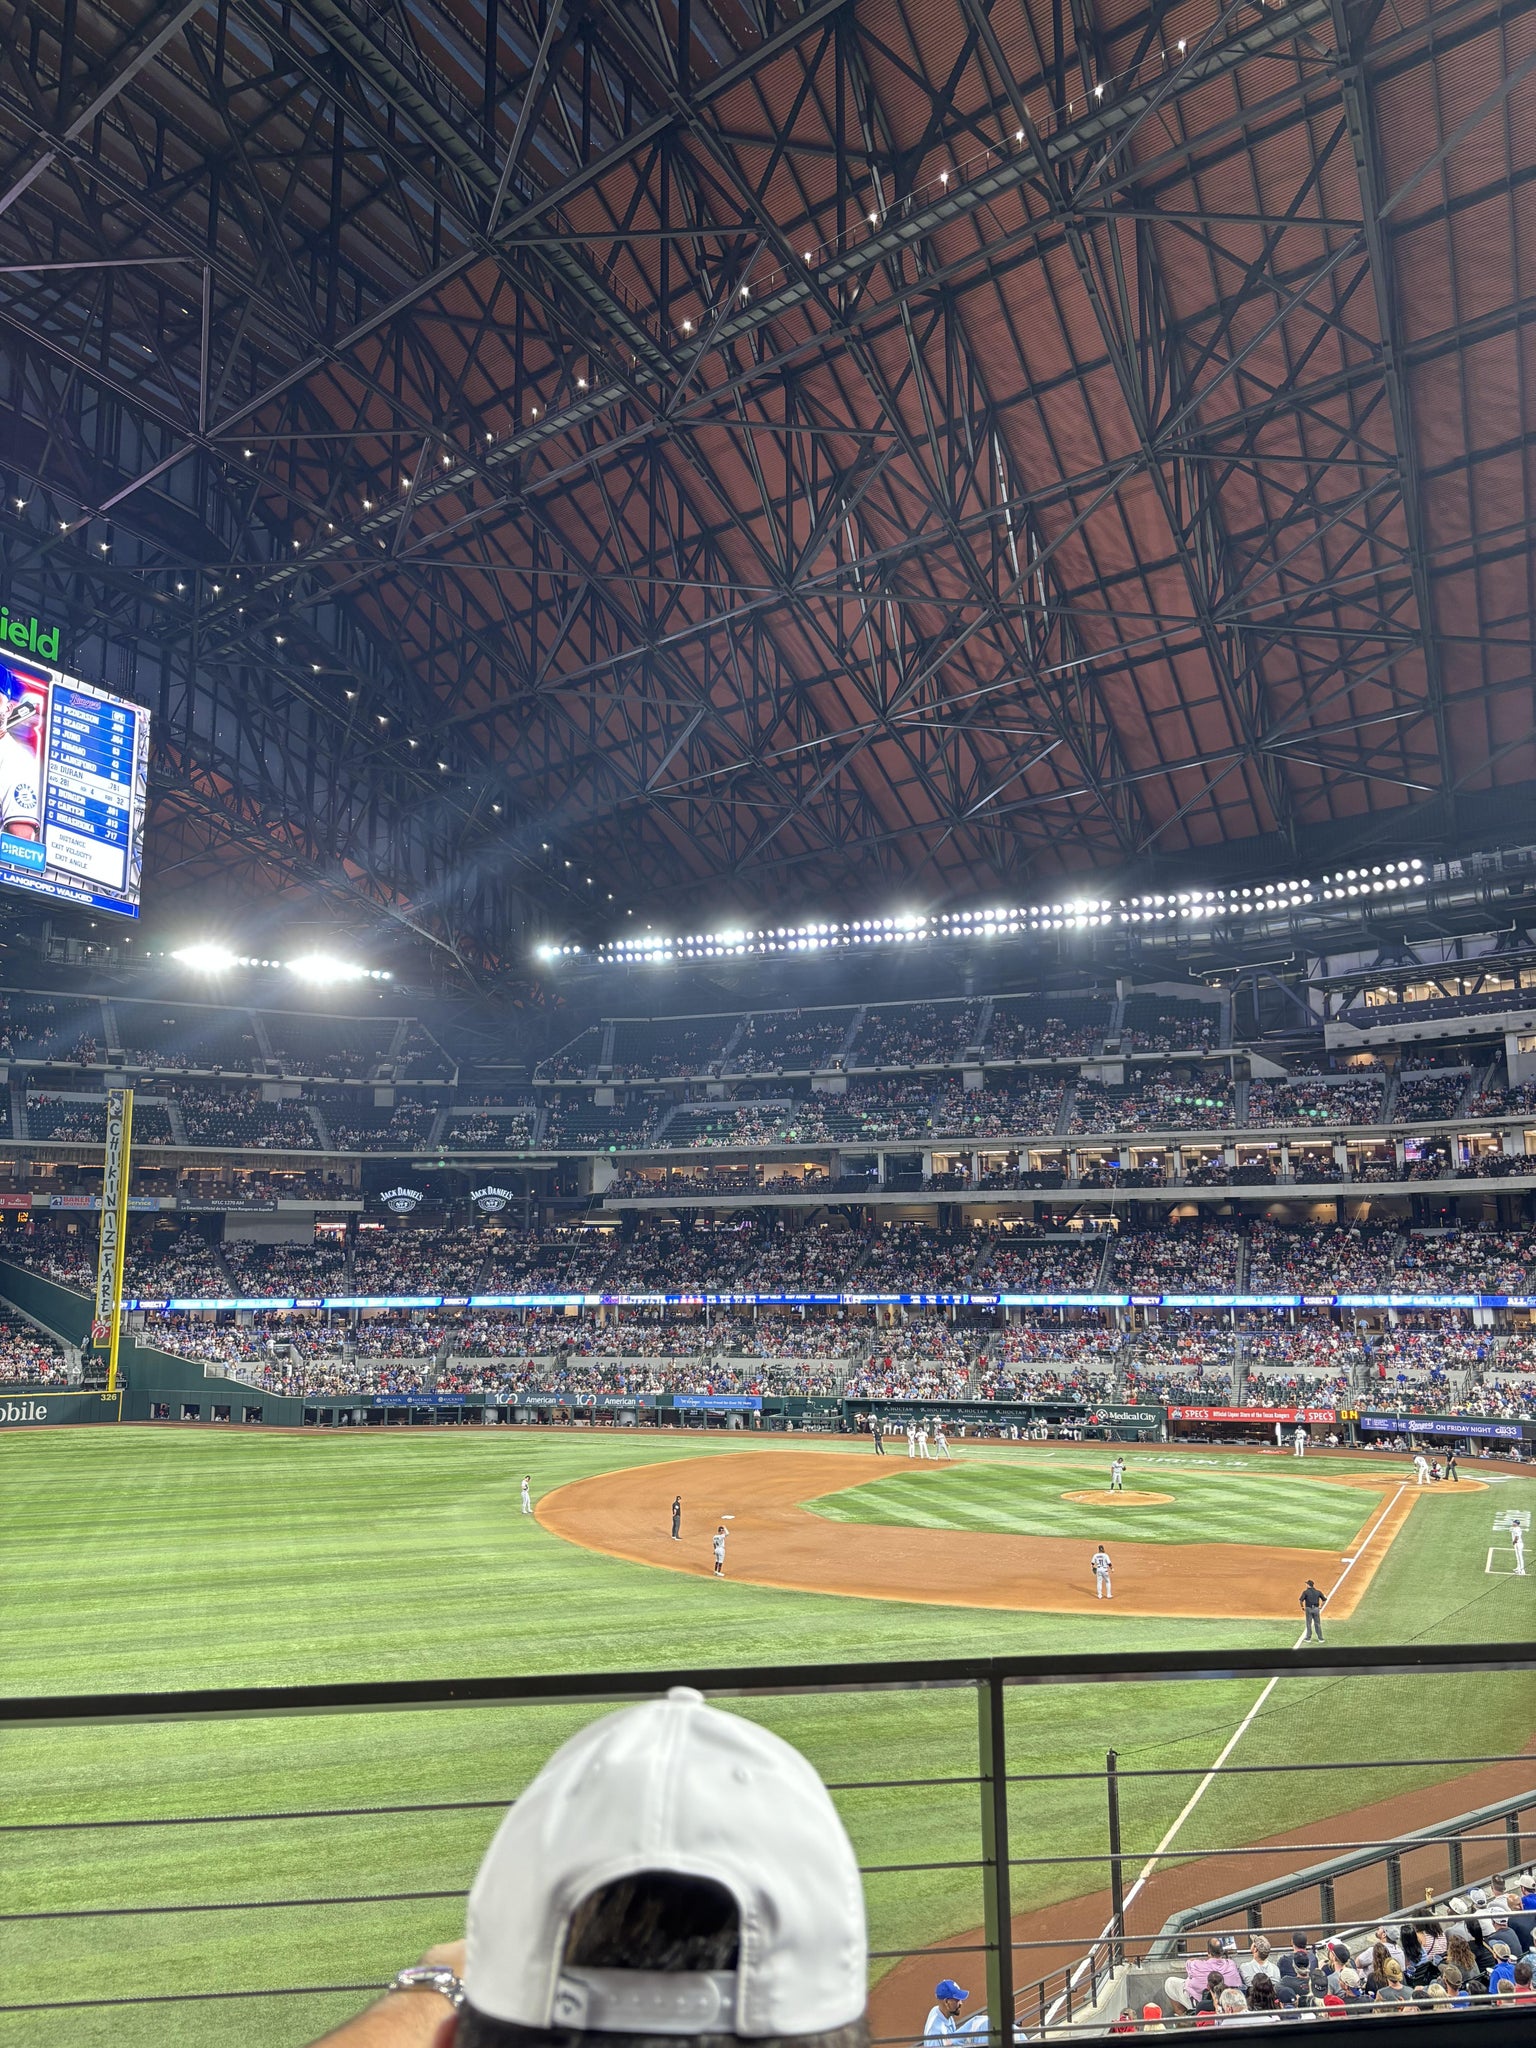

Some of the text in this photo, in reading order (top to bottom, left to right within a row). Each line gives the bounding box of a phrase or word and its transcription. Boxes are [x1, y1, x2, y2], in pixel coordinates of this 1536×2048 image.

[60, 765, 83, 779] DURAN
[59, 834, 86, 848] DISTANCE
[1, 842, 44, 863] DIRECTV
[66, 846, 92, 860] VELOCITY
[55, 853, 88, 869] EXIT ANGLE
[3, 873, 56, 893] LANGFORD
[57, 886, 93, 903] WALKED
[380, 1186, 424, 1201] JACK DANIEL'S
[470, 1186, 514, 1200] JACK DANIEL'S
[104, 1216, 116, 1243] IZ
[101, 1253, 113, 1313] FARE
[100, 1393, 117, 1401] 326
[525, 1396, 556, 1404] American
[604, 1397, 636, 1405] American
[1109, 1411, 1156, 1422] Medical City
[1185, 1410, 1209, 1418] SPEC'S
[1308, 1411, 1334, 1421] SPEC'S
[1408, 1421, 1433, 1432] Rangers
